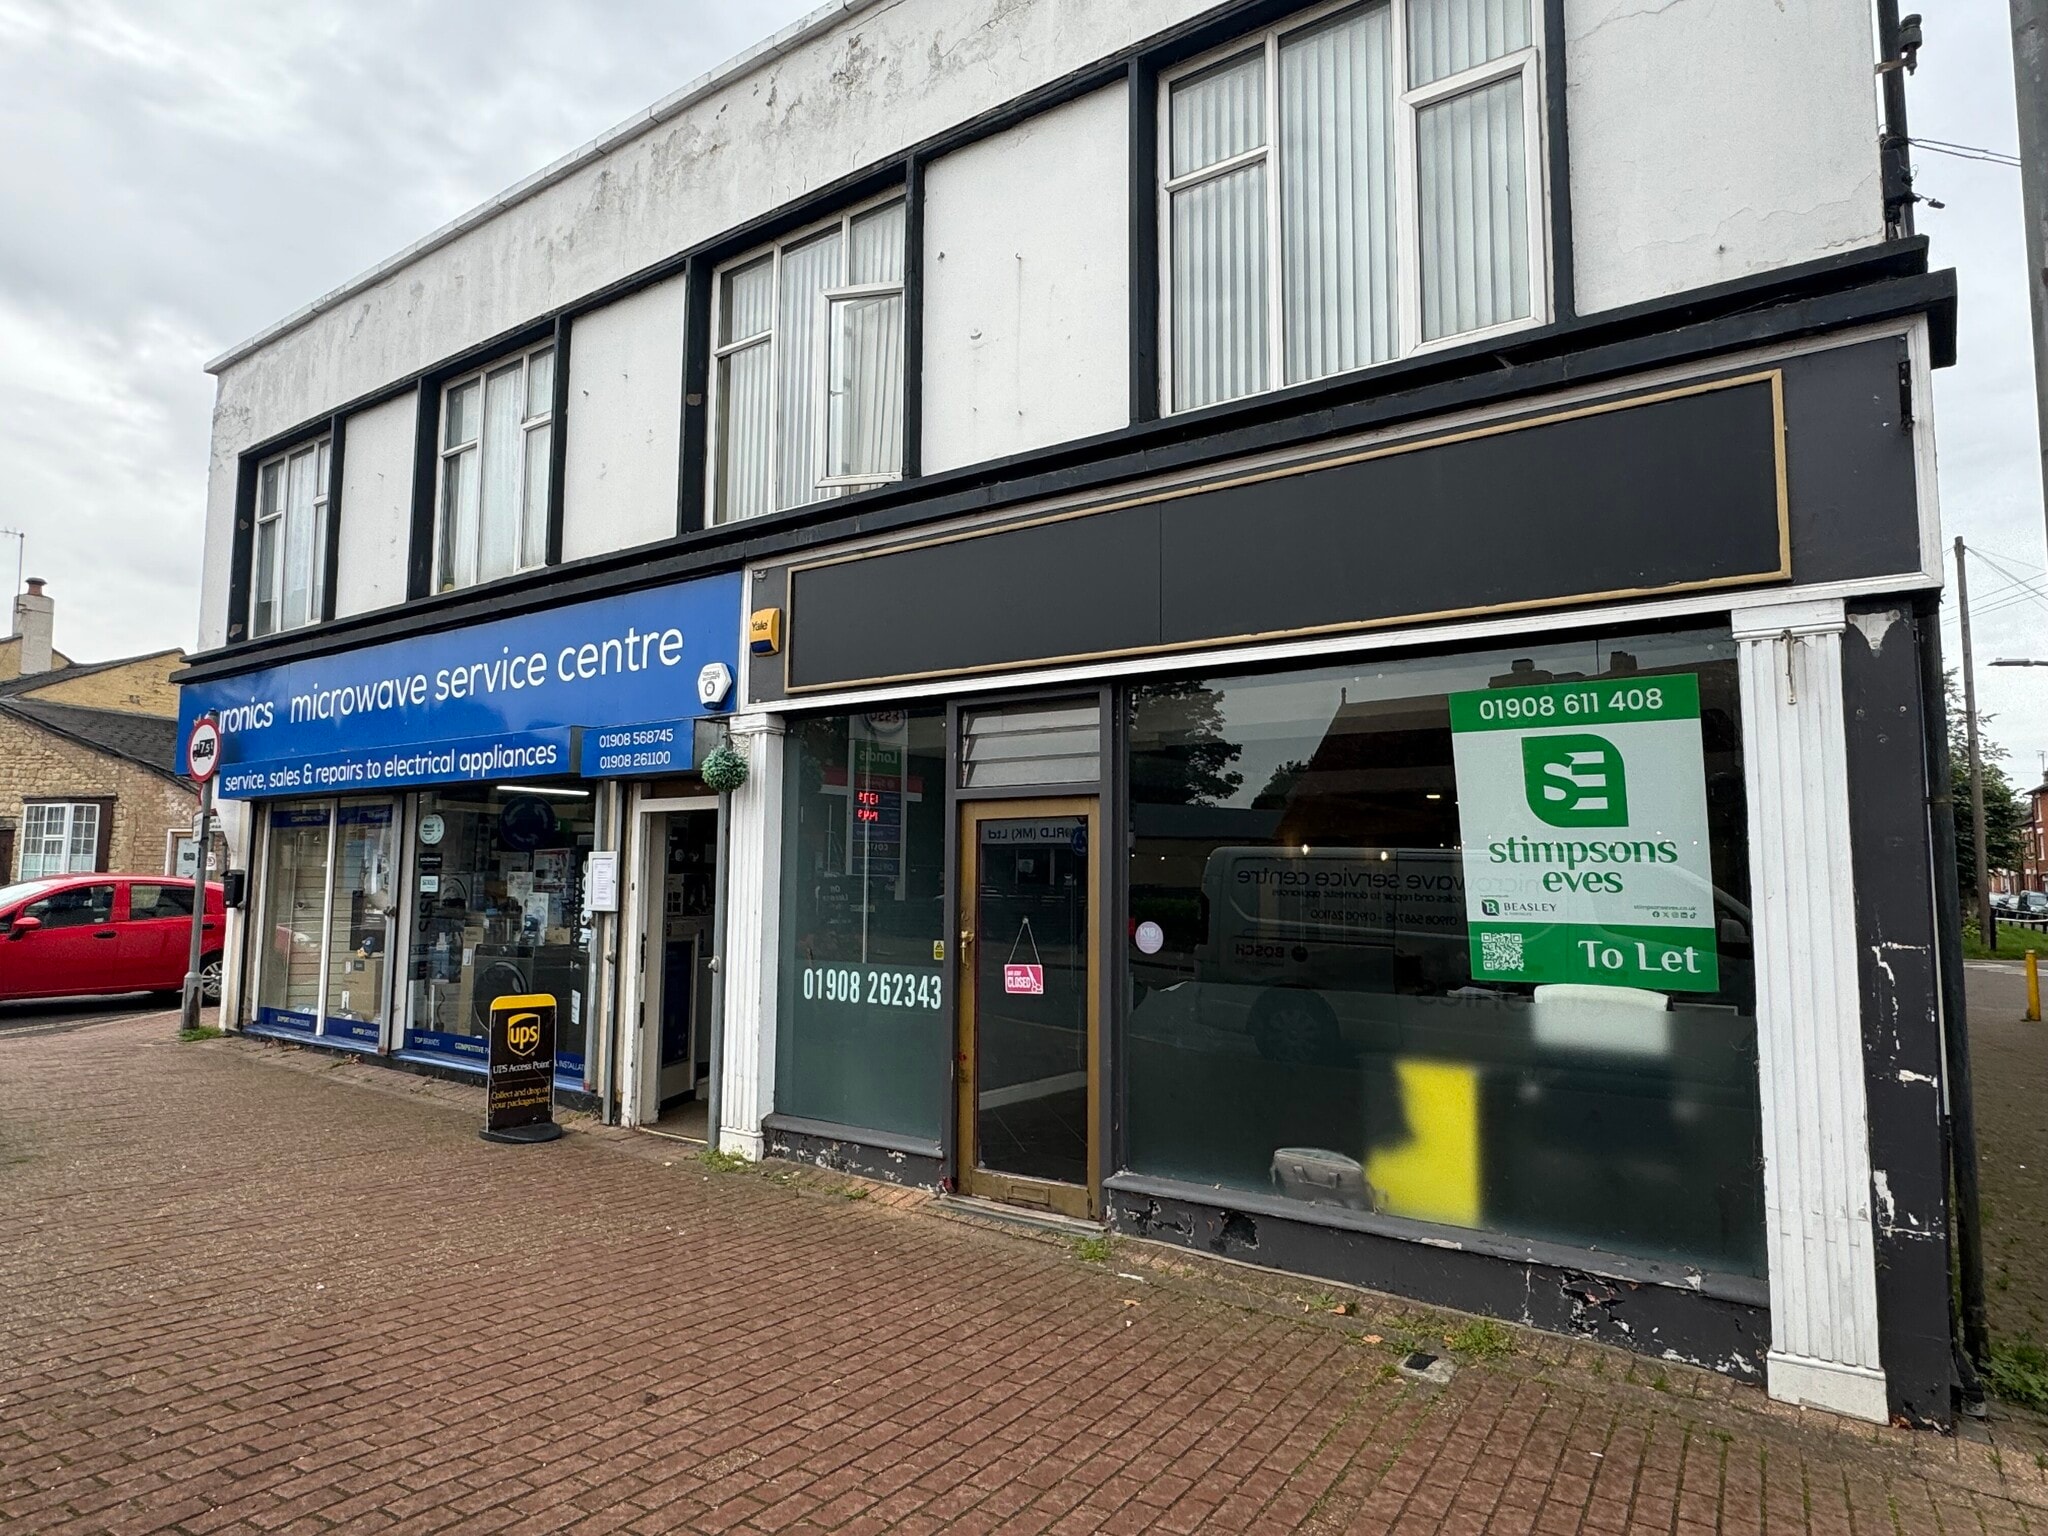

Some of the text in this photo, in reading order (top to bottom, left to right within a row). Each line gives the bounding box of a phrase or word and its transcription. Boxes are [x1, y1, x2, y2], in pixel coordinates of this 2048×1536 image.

[752, 620, 768, 632] Yale
[217, 627, 683, 734] ronics microwave service centre
[1479, 687, 1664, 721] 01908 611 408
[599, 728, 674, 748] 01908 568745
[225, 743, 557, 792] service, sales & repairs to electrical appliances
[600, 751, 671, 769] 01908 261100
[1488, 835, 1679, 870] stimpsons
[1543, 870, 1624, 893] eves
[1504, 902, 1557, 912] BEASLEY
[1578, 940, 1702, 974] To Let
[803, 967, 942, 1010] 01908 262343
[1007, 976, 1031, 988] CLOSED
[510, 1025, 538, 1050] ups
[493, 1060, 550, 1075] UPS Access Point
